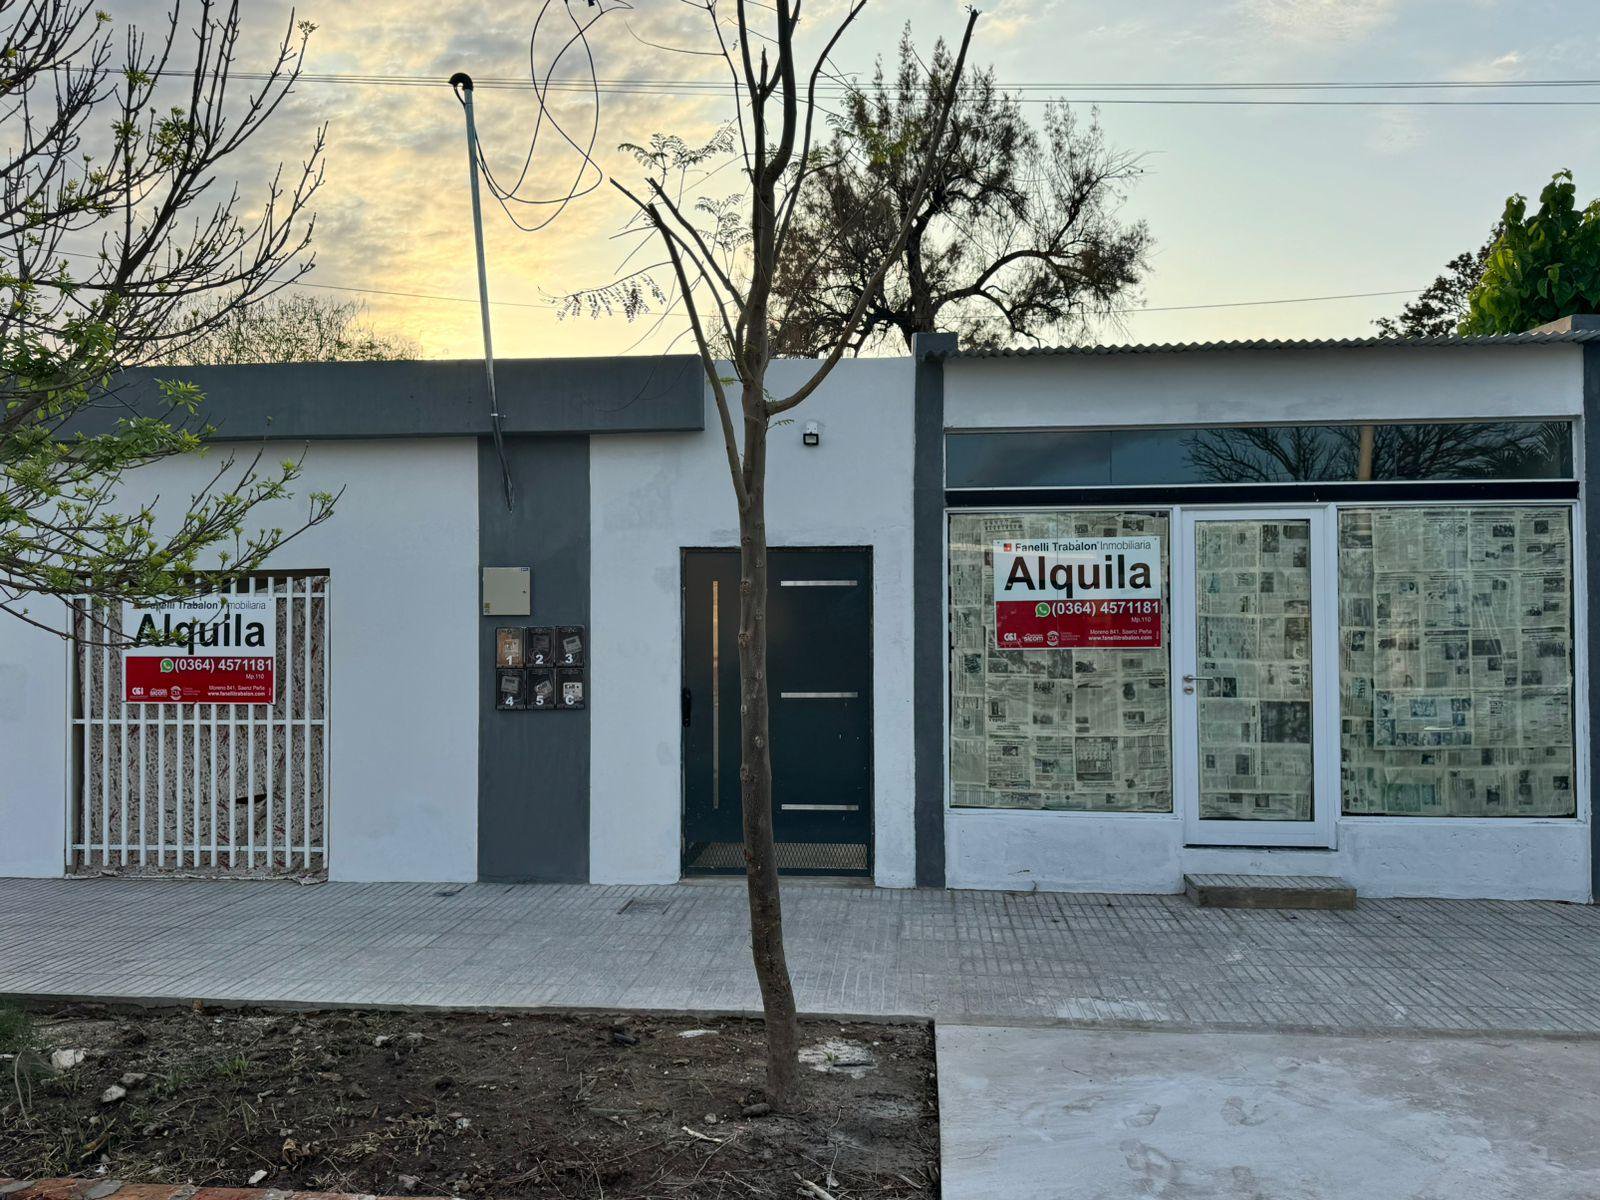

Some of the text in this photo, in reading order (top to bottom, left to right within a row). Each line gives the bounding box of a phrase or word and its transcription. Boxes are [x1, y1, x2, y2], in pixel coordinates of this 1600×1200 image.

[1015, 540, 1151, 552] Fanelli Trabalon Inmobiliaria
[1004, 554, 1152, 598] Alquila
[179, 600, 218, 609] Trabalon
[1052, 601, 1159, 617] (0364) 4571181
[135, 613, 265, 655] Alquila
[506, 655, 513, 665] 1
[535, 654, 544, 664] 2
[565, 653, 574, 664] 3
[175, 659, 272, 673] (0364) 4571181
[505, 696, 514, 706] 4
[536, 695, 544, 706] 5
